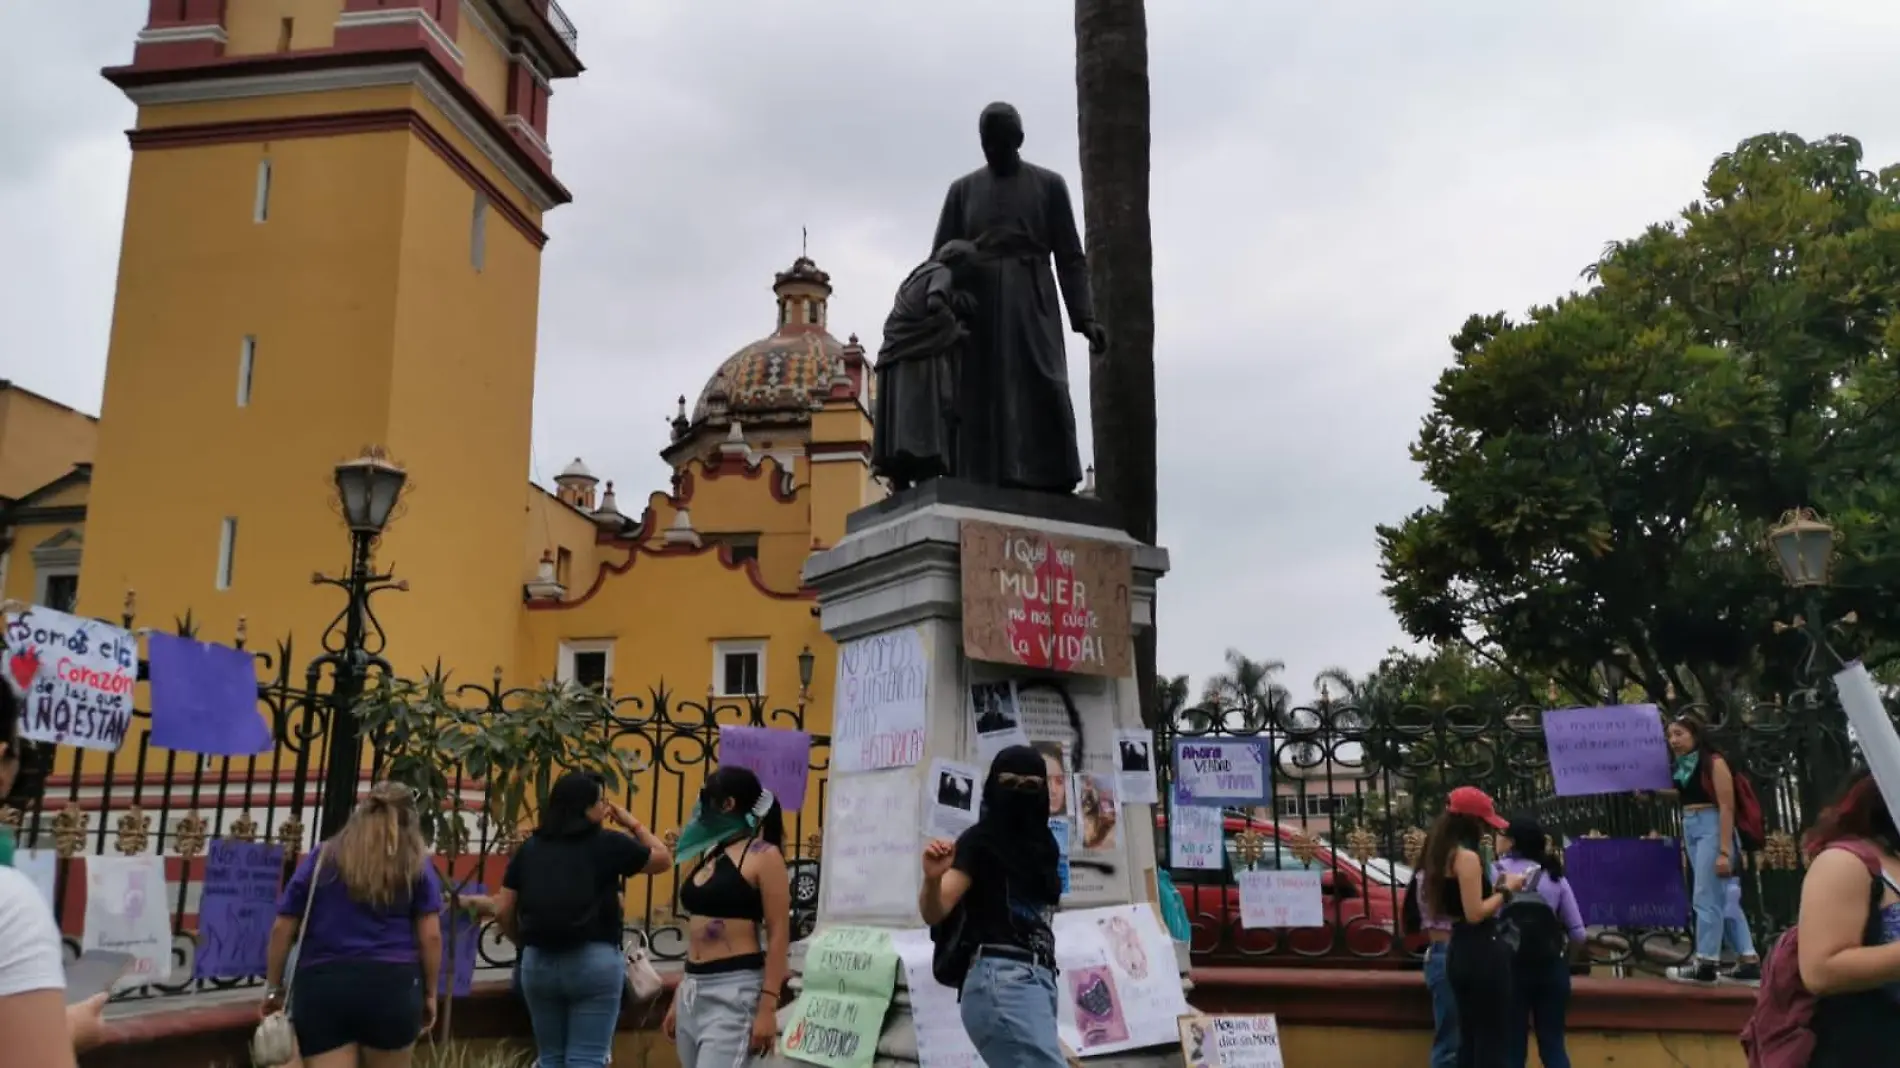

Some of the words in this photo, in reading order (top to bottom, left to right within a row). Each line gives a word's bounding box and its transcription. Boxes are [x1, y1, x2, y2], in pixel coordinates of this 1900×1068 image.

[1055, 547, 1077, 567] ser
[999, 570, 1086, 610] MUJER
[1007, 607, 1027, 623] no
[1031, 611, 1052, 627] nos
[57, 656, 135, 696] Corazón
[35, 679, 55, 695] de
[64, 683, 89, 702] las
[96, 693, 123, 709] que
[1182, 746, 1223, 760] Ahora
[820, 951, 874, 973] EXISTENCIA
[837, 977, 847, 996] O
